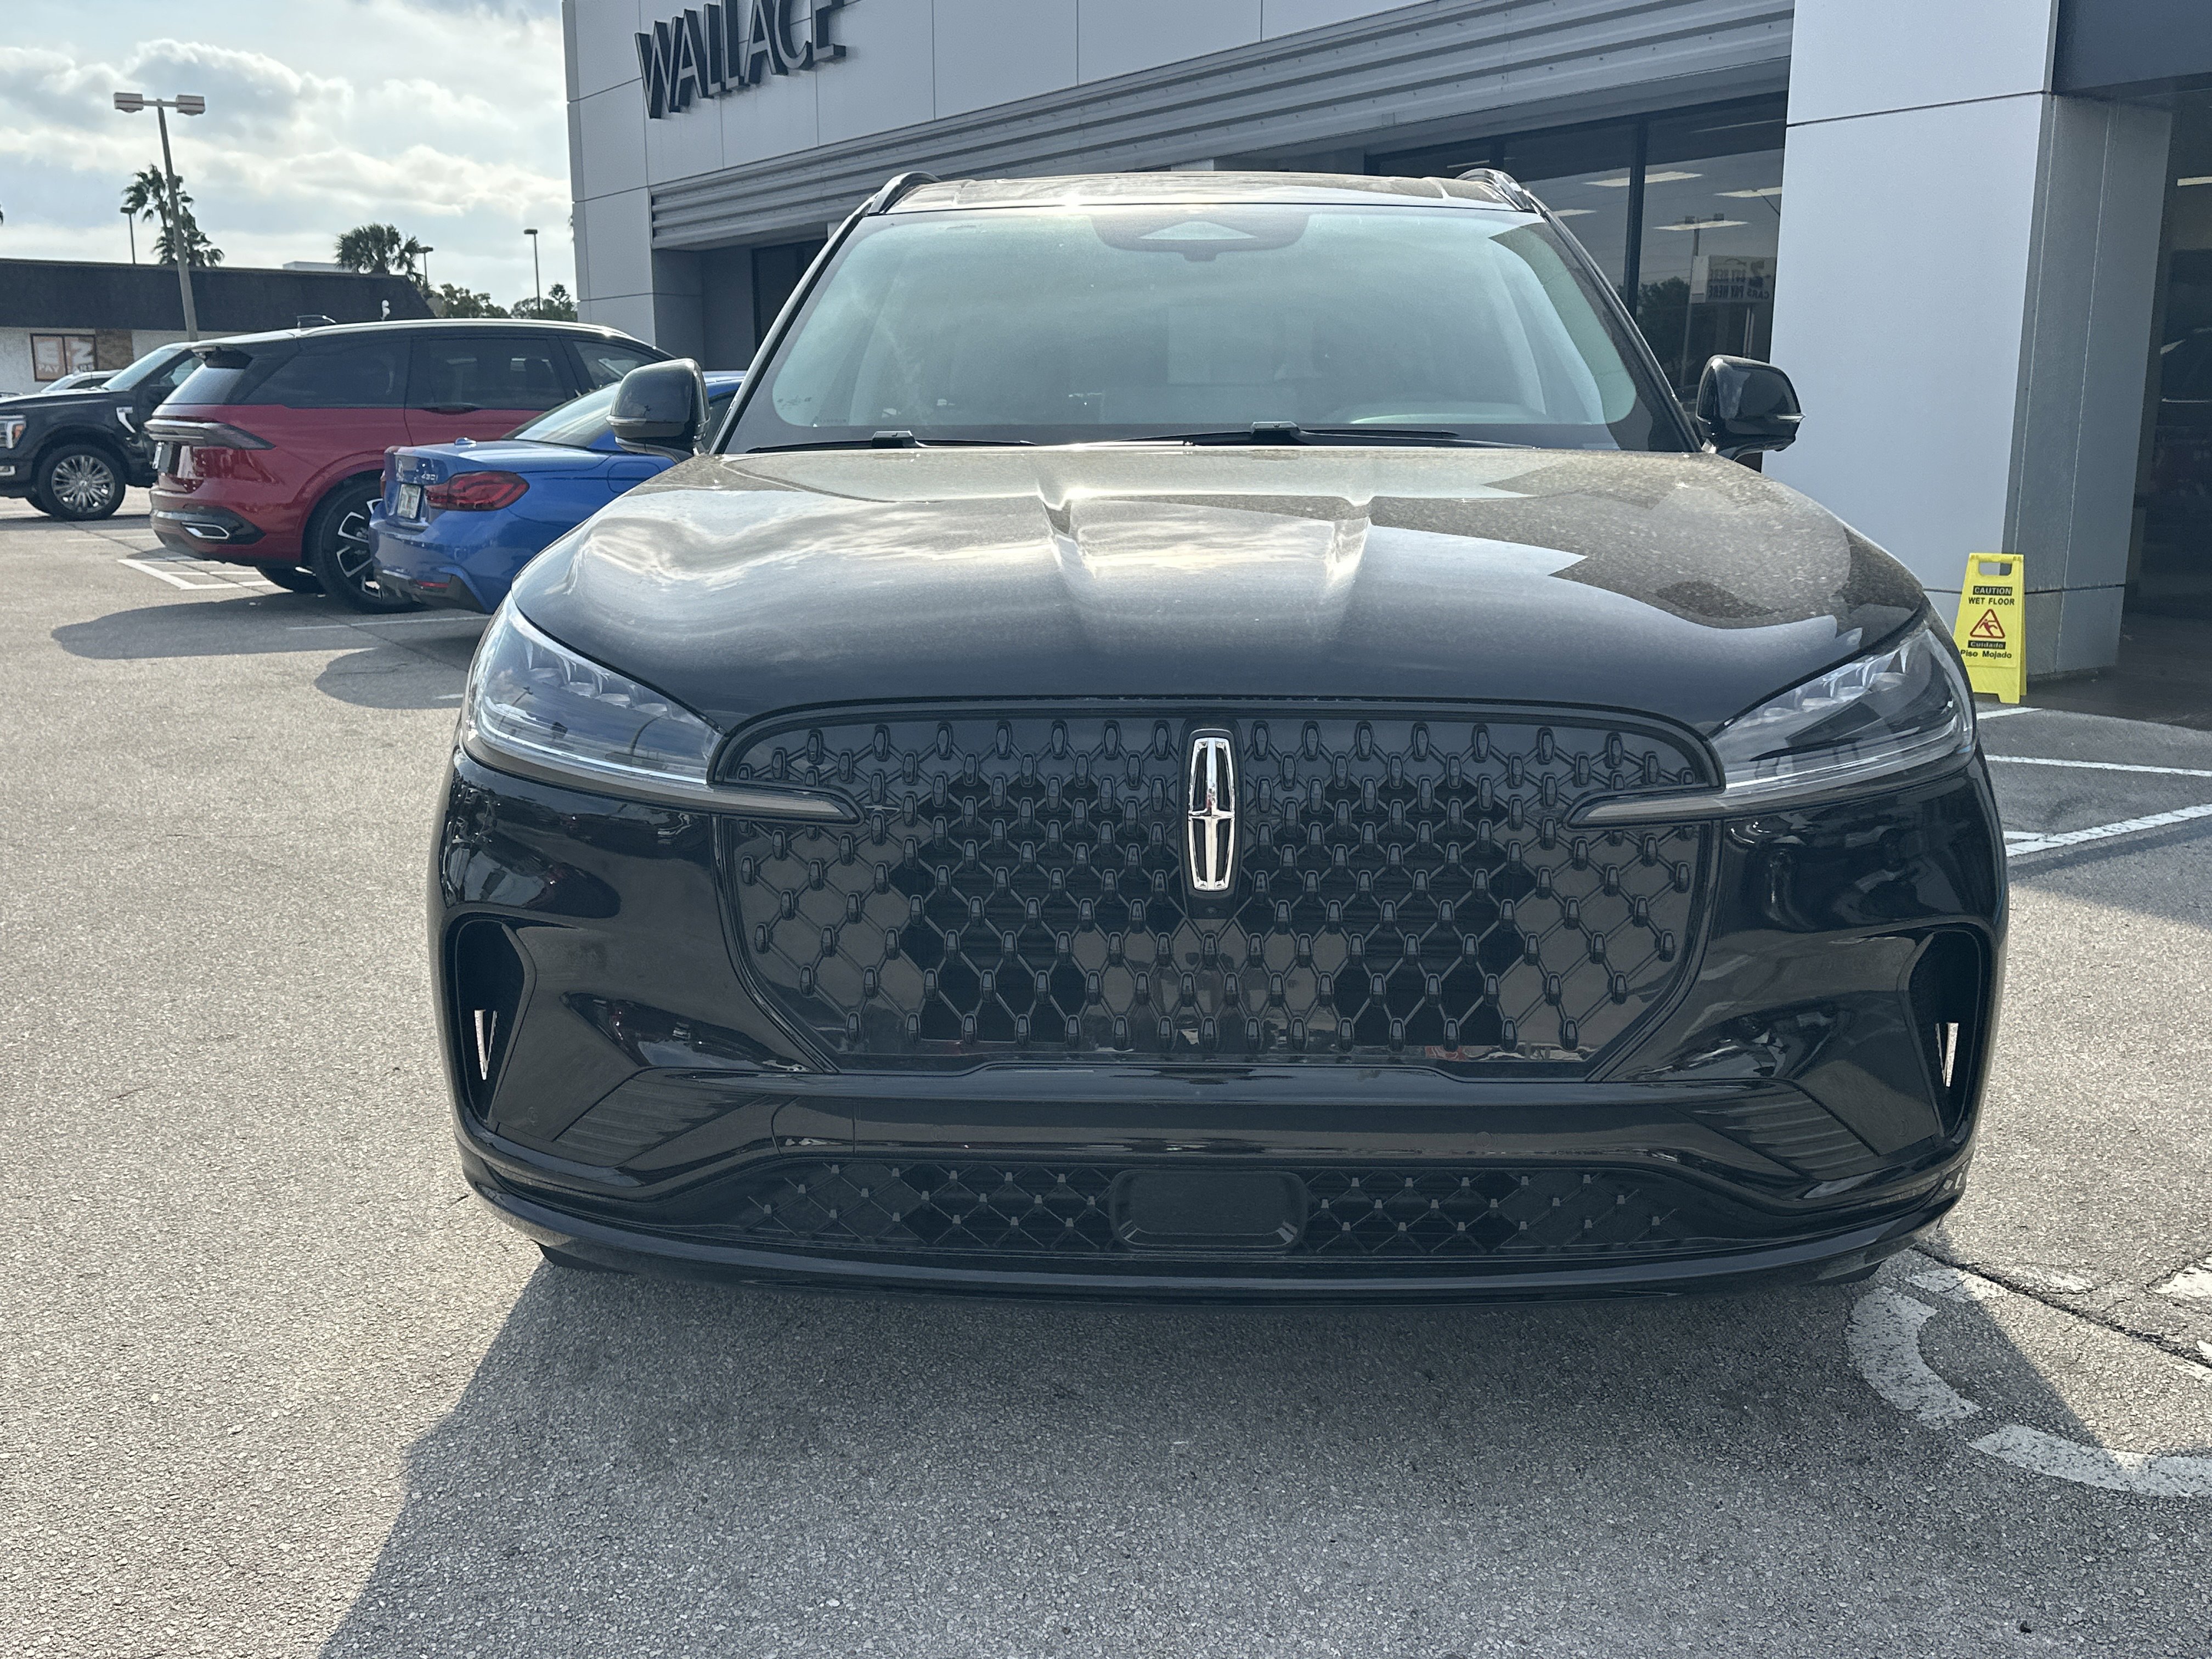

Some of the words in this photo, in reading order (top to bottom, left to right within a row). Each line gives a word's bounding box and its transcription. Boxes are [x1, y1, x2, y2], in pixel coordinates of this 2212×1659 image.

[635, 0, 846, 119] WALLACE
[1974, 586, 2012, 595] CAUTION
[1988, 597, 2015, 606] FLOOR
[1960, 649, 1978, 657] Piso
[1982, 650, 2012, 659] Mojado
